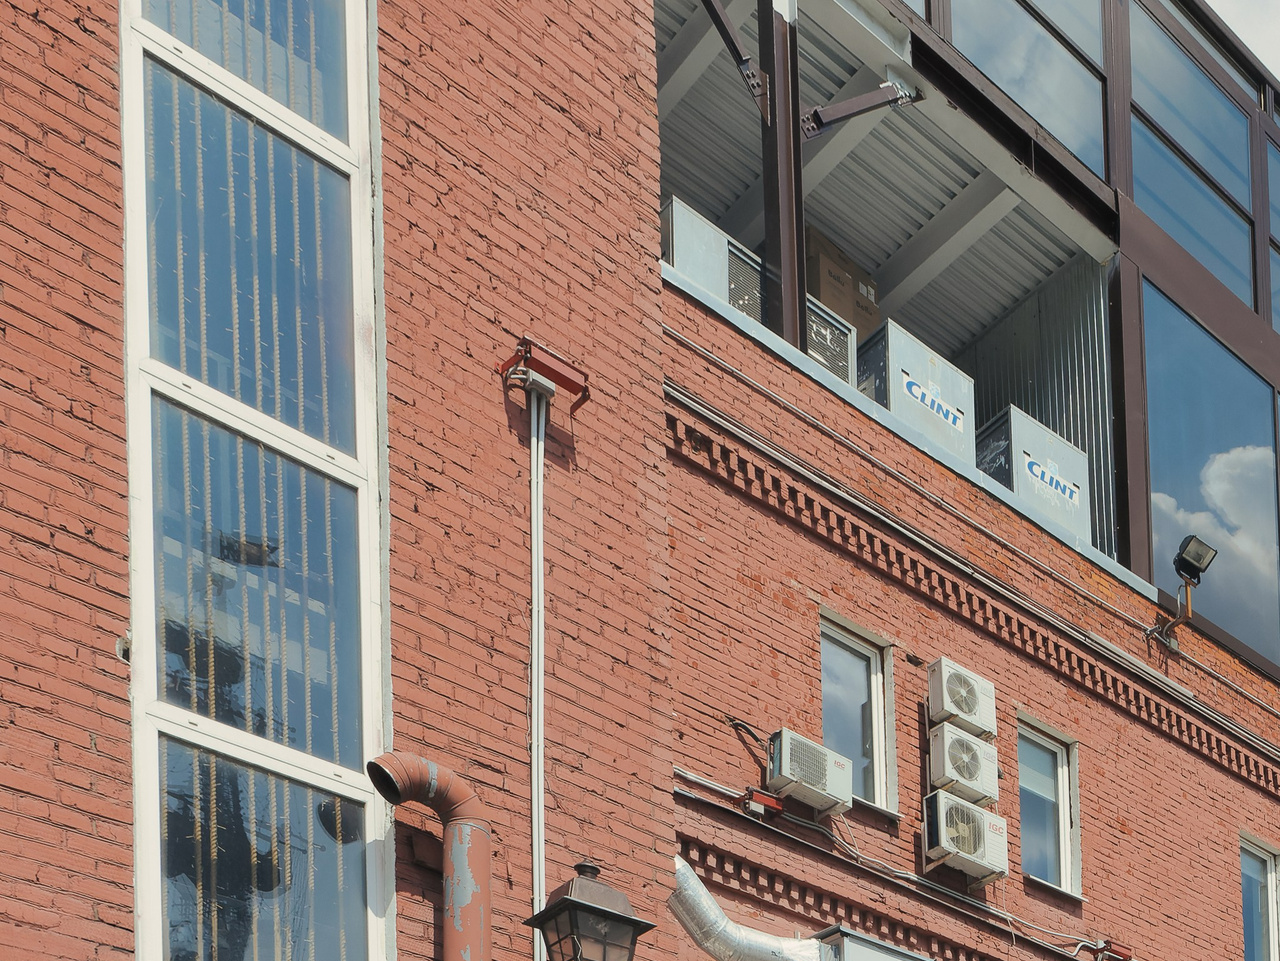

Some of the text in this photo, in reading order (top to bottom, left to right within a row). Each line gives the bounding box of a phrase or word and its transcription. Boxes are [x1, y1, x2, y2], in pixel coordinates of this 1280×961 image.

[906, 380, 961, 427] CLINT
[1027, 460, 1077, 500] CLINT
[988, 821, 1004, 835] IGC
